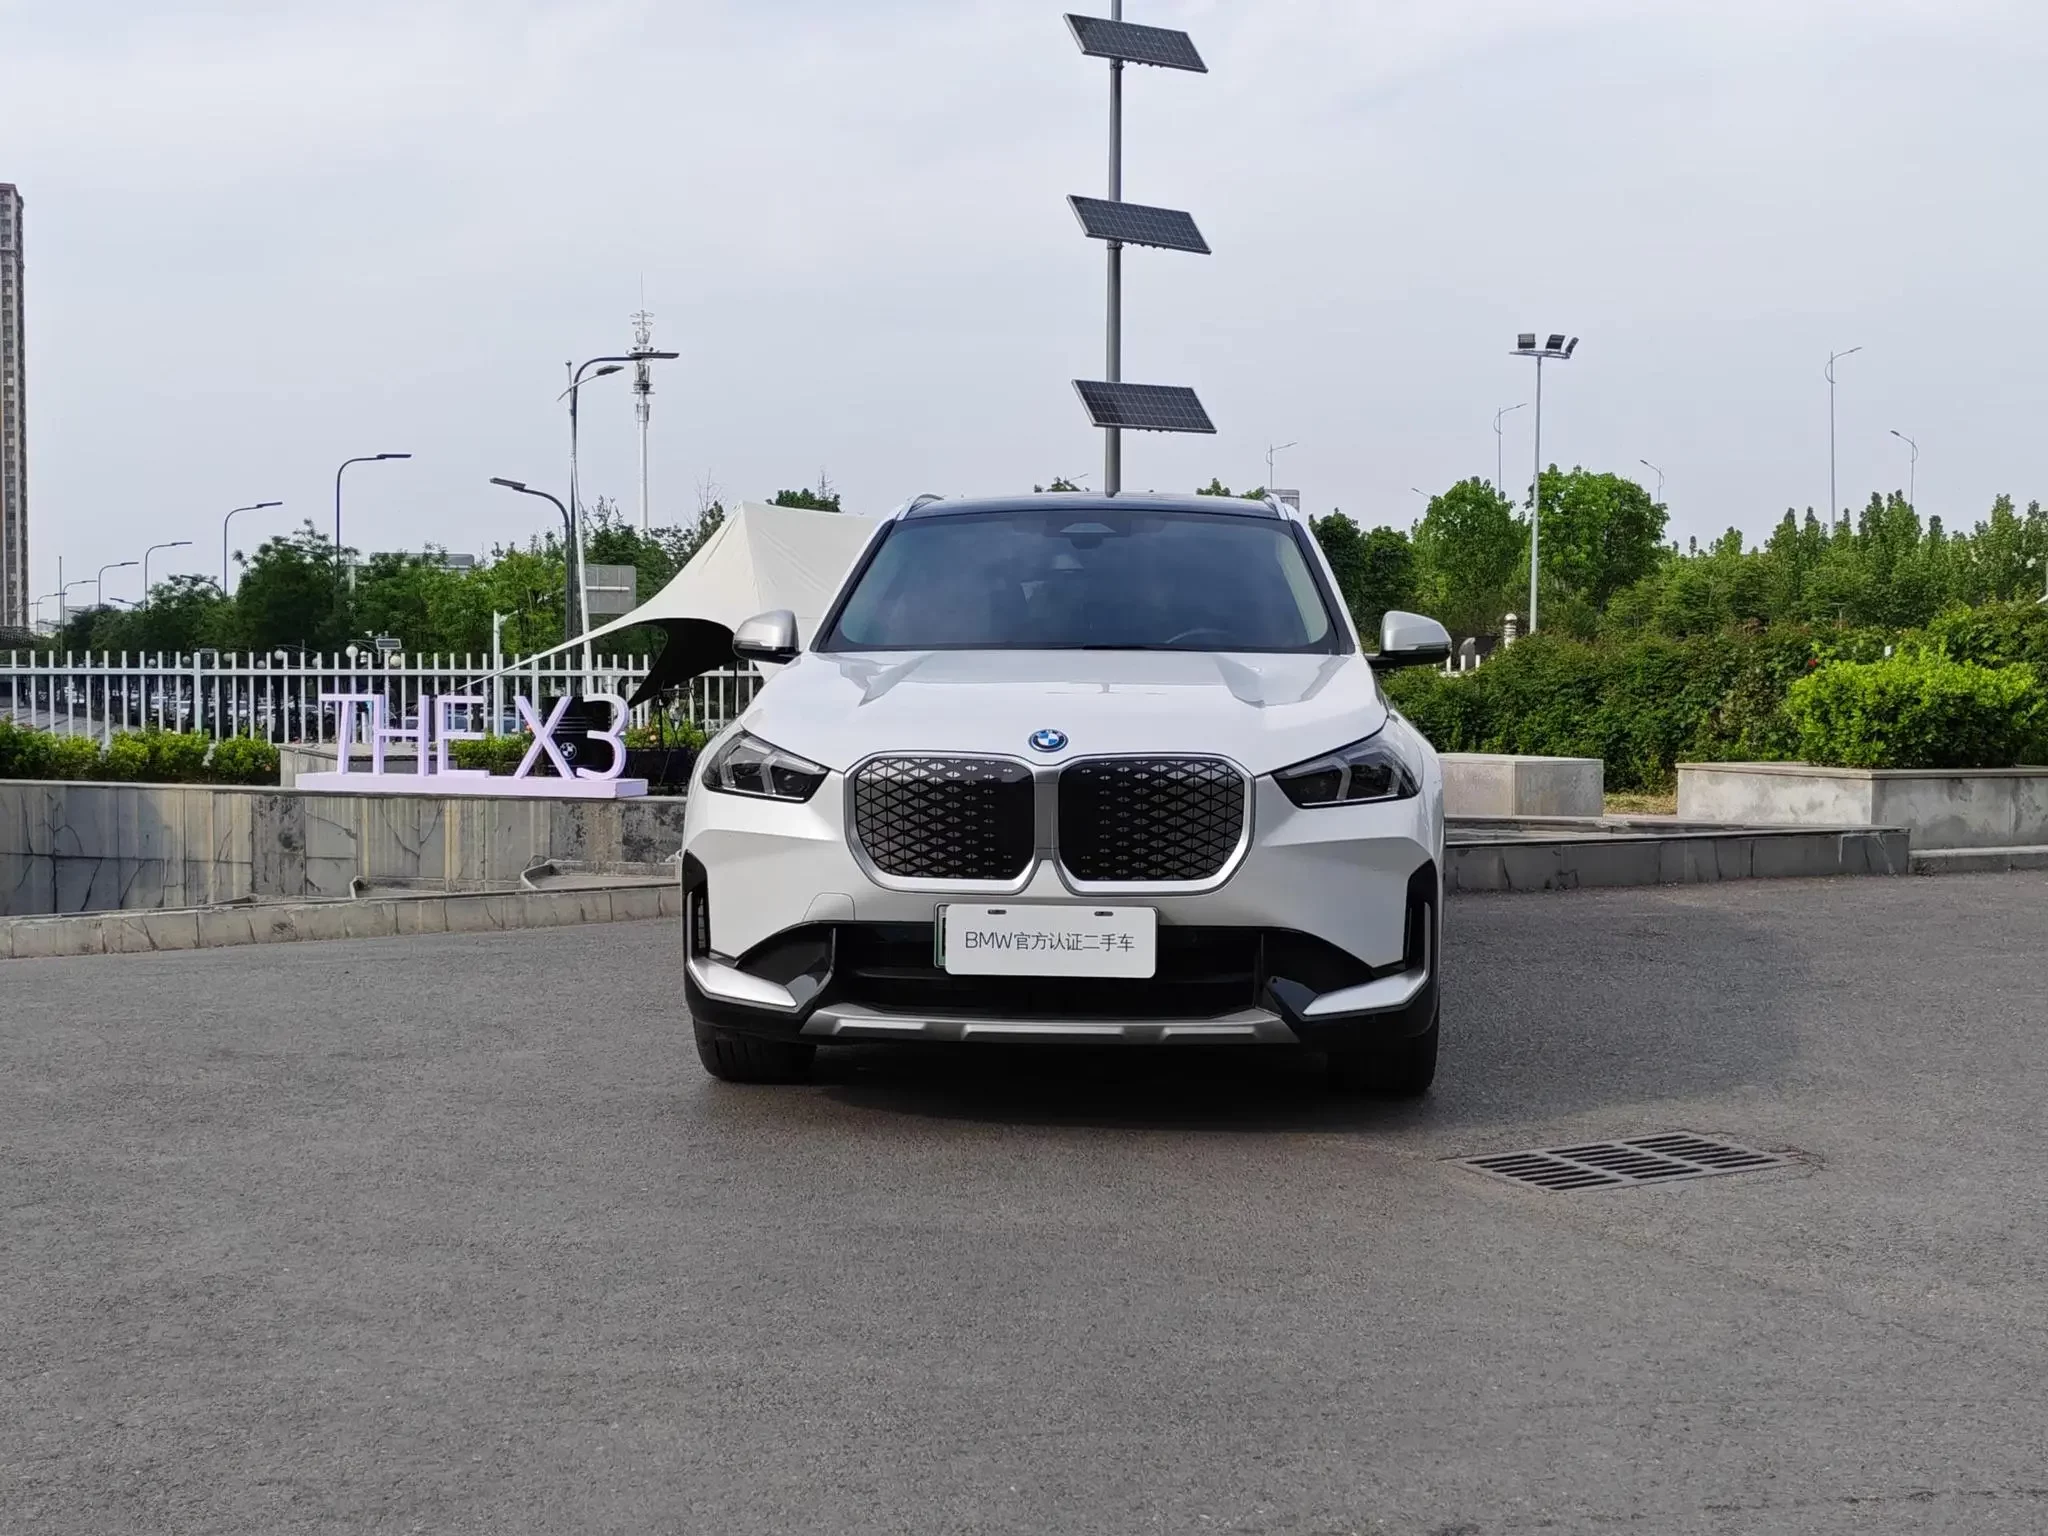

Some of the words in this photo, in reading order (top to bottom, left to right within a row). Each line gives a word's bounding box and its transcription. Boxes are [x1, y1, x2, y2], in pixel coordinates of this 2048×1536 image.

[319, 693, 490, 778] THE
[514, 693, 629, 780] X3
[965, 930, 1135, 952] BMW官方认证二手车
